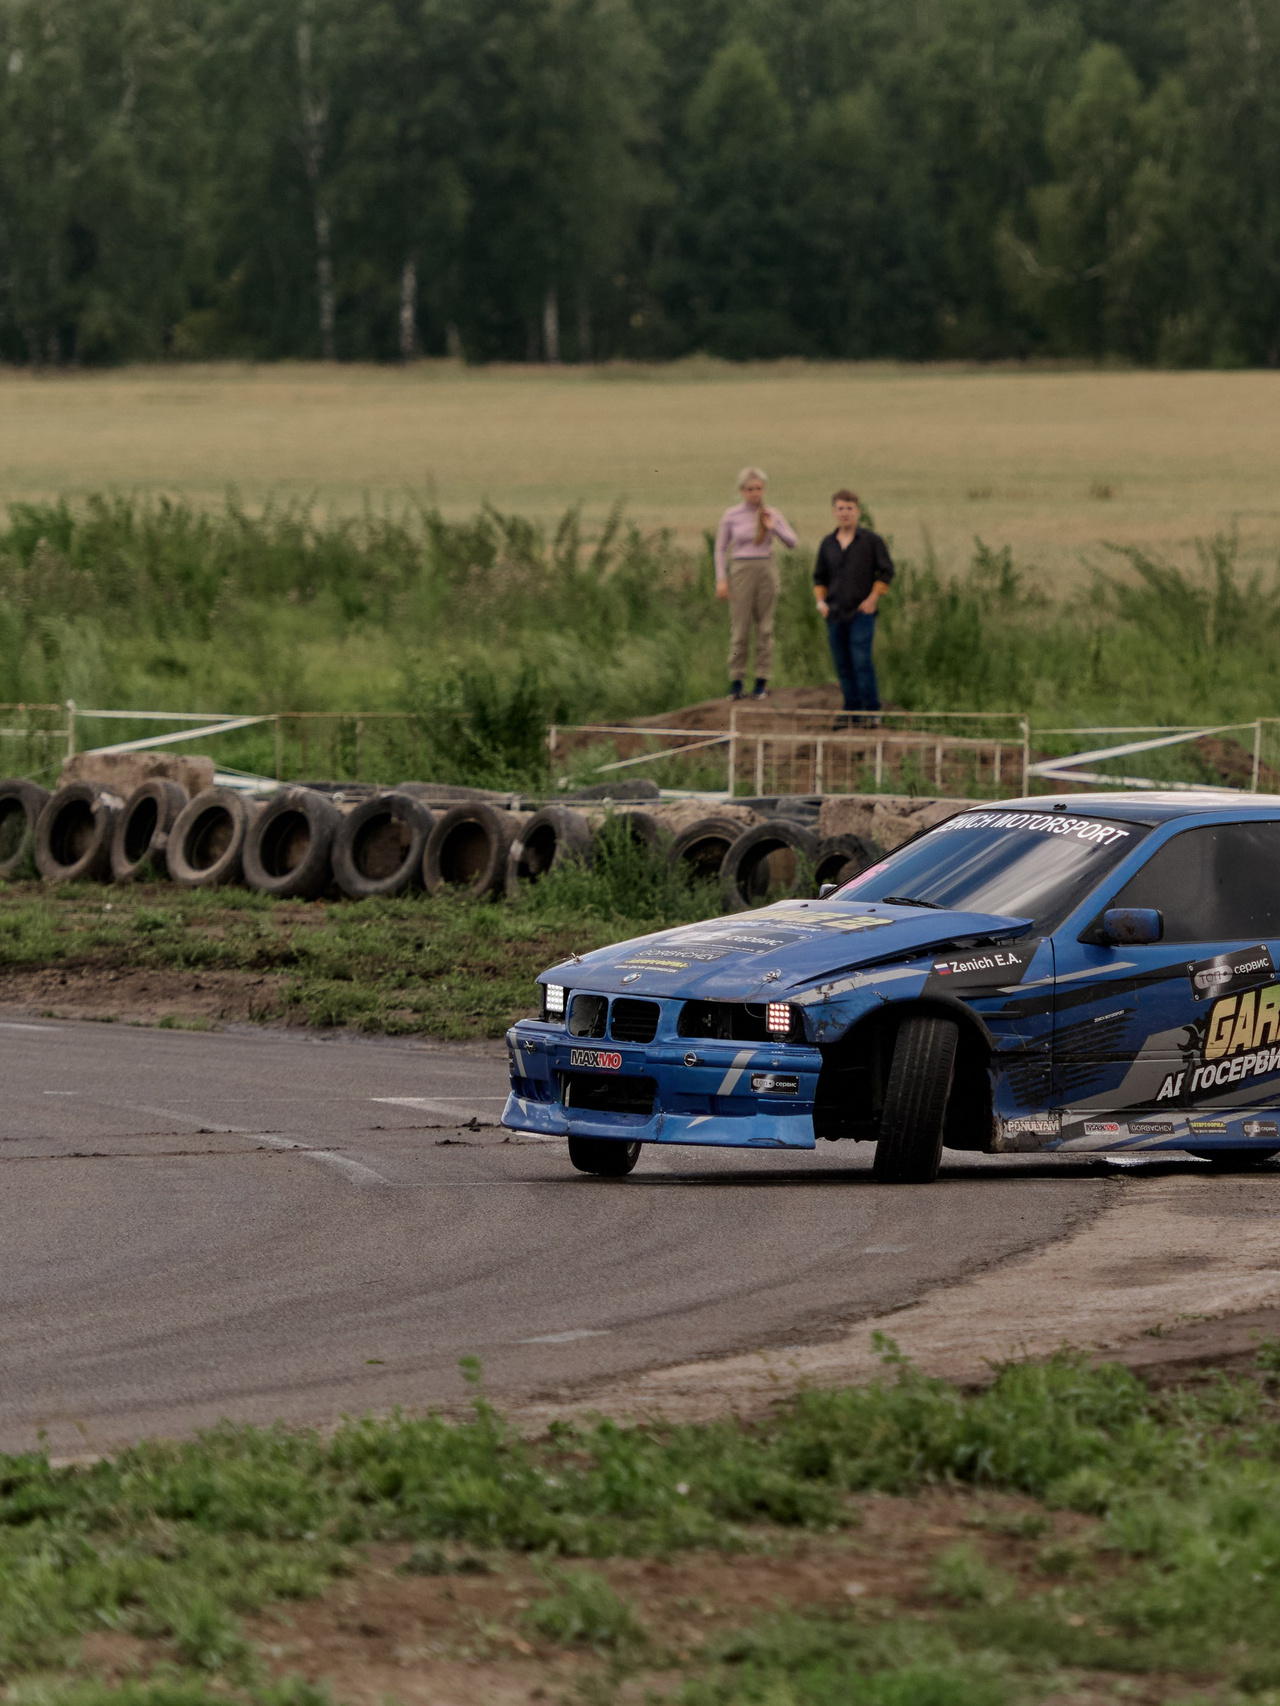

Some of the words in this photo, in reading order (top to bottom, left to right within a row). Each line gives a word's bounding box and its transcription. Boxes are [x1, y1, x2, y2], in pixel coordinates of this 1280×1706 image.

[990, 814, 1131, 846] MOTORSPORT
[949, 957, 994, 973] Zenich
[994, 952, 1023, 966] E.A.
[1200, 971, 1222, 985] ТОП
[1234, 957, 1269, 975] сервис
[571, 1049, 622, 1069] MAXMO
